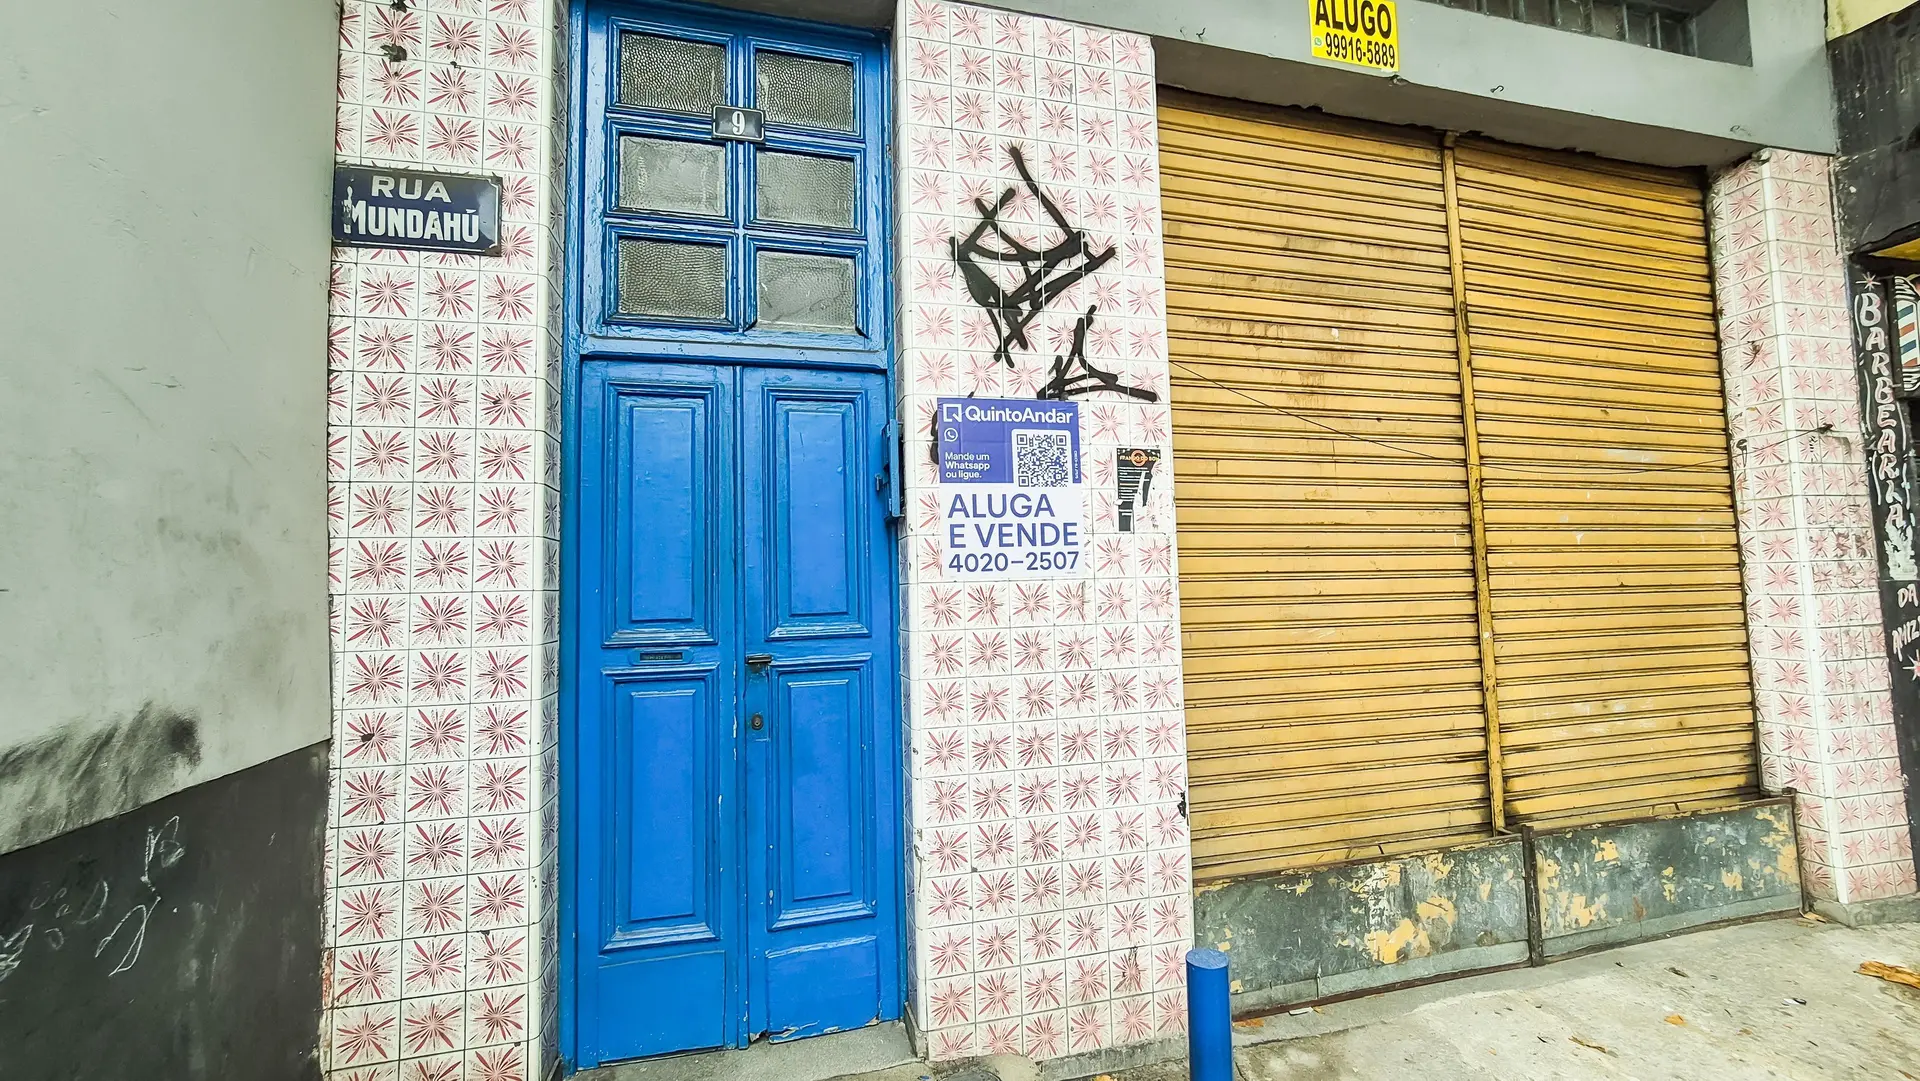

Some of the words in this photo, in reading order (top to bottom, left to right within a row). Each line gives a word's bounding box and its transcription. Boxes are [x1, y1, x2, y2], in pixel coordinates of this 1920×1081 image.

[1315, 0, 1392, 39] ALUGO
[1325, 32, 1395, 68] 99916-5889
[732, 111, 745, 135] 9
[371, 175, 451, 203] RUA
[343, 200, 480, 243] MUNDAHÚ
[965, 405, 1073, 424] QuintoAndar
[945, 452, 974, 461] Mande
[976, 453, 990, 461] um
[945, 461, 990, 471] Whatsapp
[958, 470, 982, 480] ligue.
[947, 493, 1055, 518] ALUGA
[949, 523, 966, 548] E
[974, 522, 1079, 548] VENDE
[948, 551, 1079, 573] 4020-2507
[1897, 583, 1919, 608] DA
[1892, 615, 1920, 662] AMIZ
